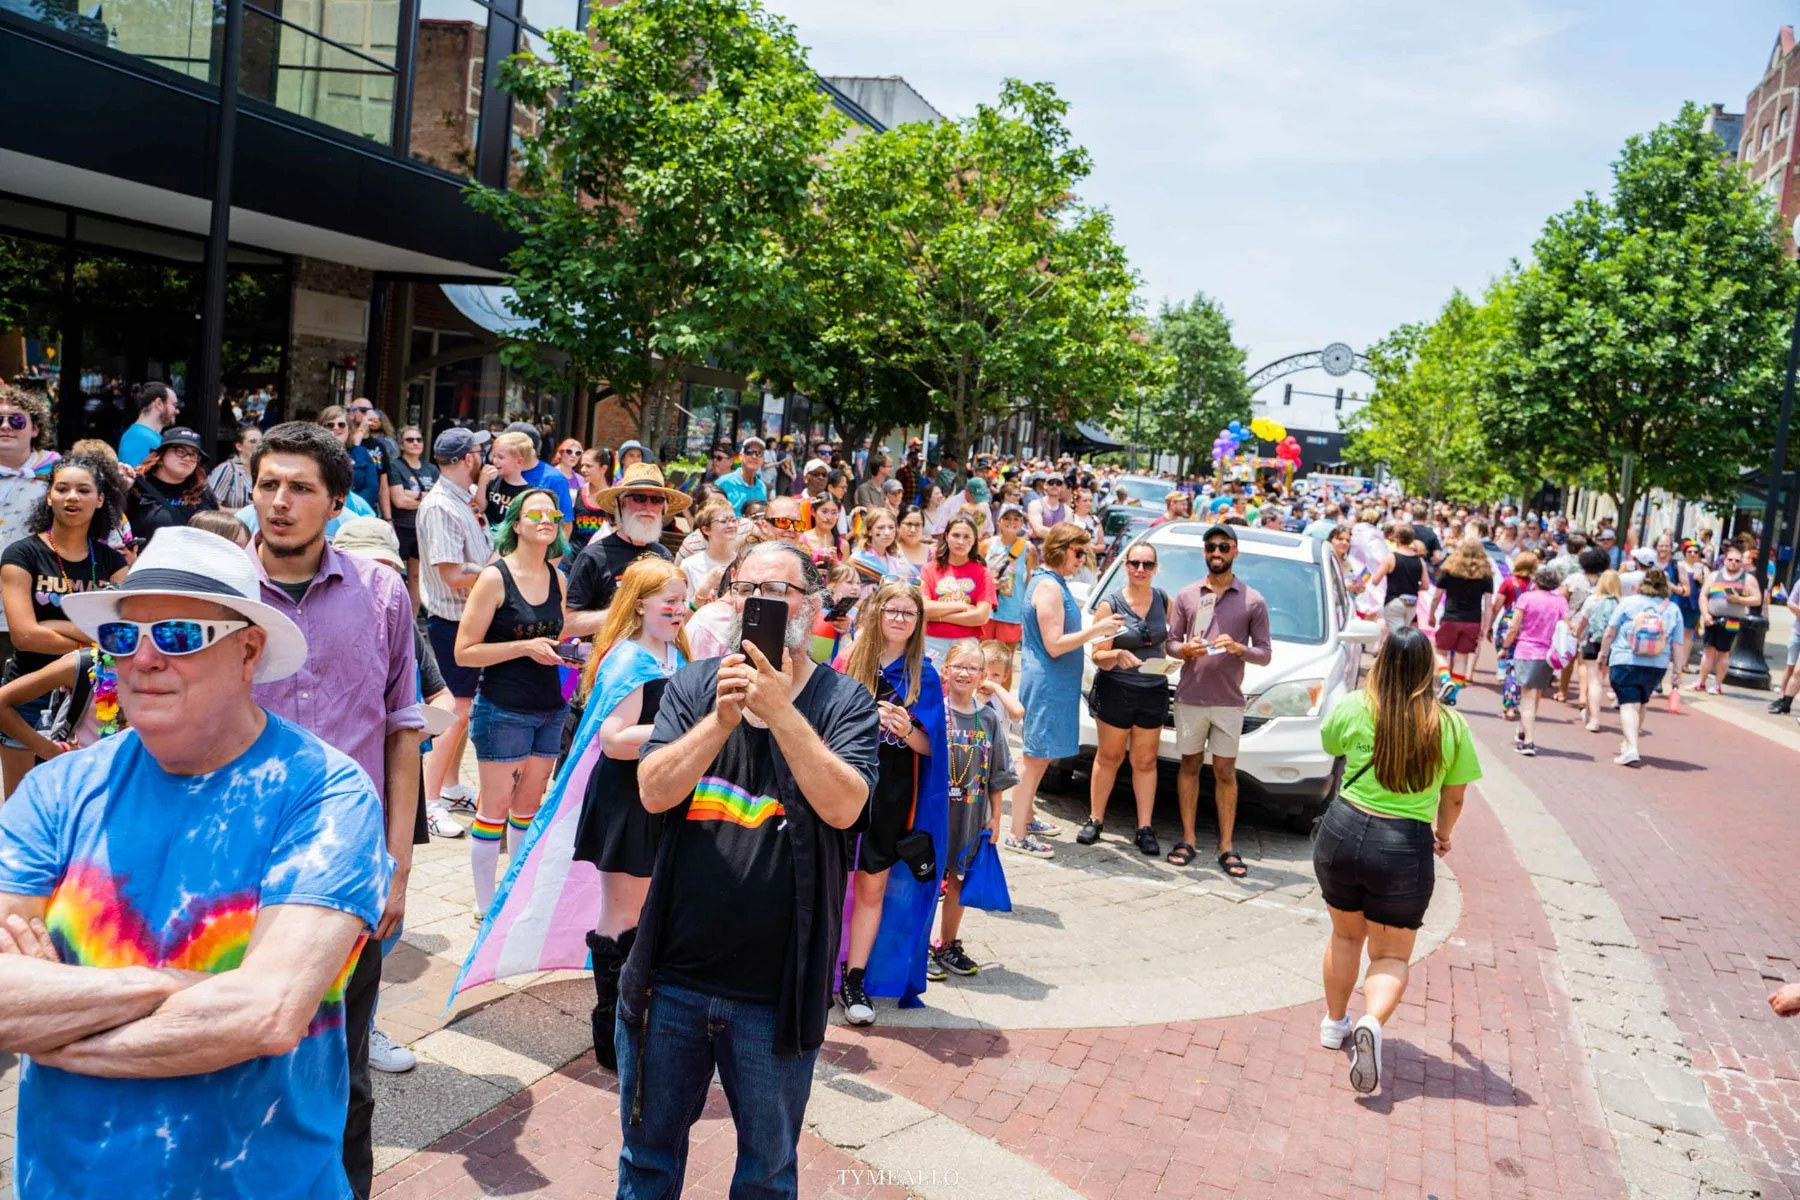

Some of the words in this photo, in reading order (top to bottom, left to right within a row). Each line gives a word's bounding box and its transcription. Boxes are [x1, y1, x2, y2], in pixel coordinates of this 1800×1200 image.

[489, 491, 514, 505] EQU
[576, 514, 607, 525] PROU
[36, 574, 104, 593] HUMA
